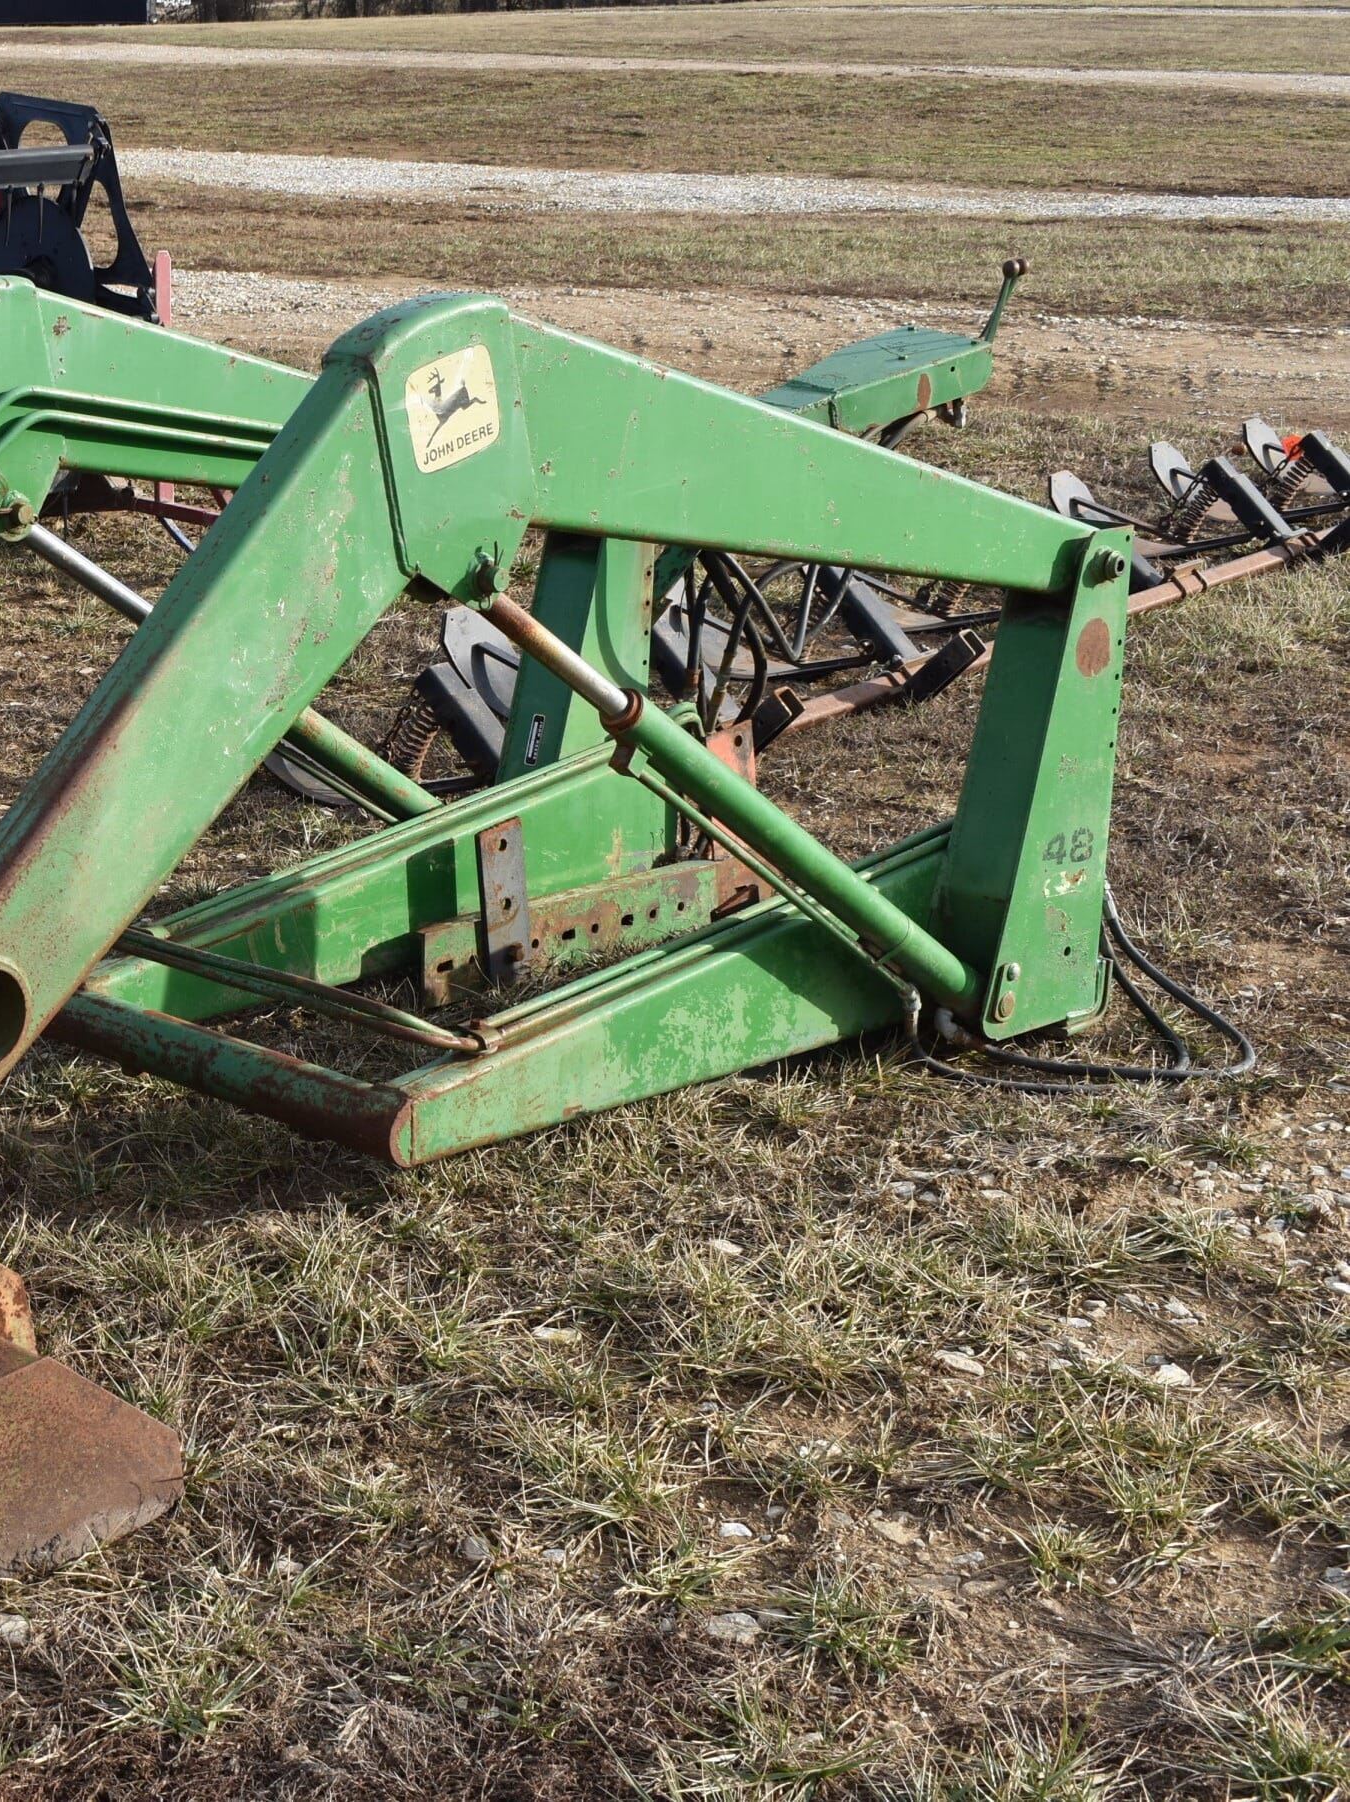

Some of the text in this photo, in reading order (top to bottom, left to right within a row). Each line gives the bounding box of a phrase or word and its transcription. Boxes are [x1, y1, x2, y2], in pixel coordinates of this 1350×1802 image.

[423, 423, 494, 465] JOHN DEERE
[1042, 826, 1094, 865] 48
